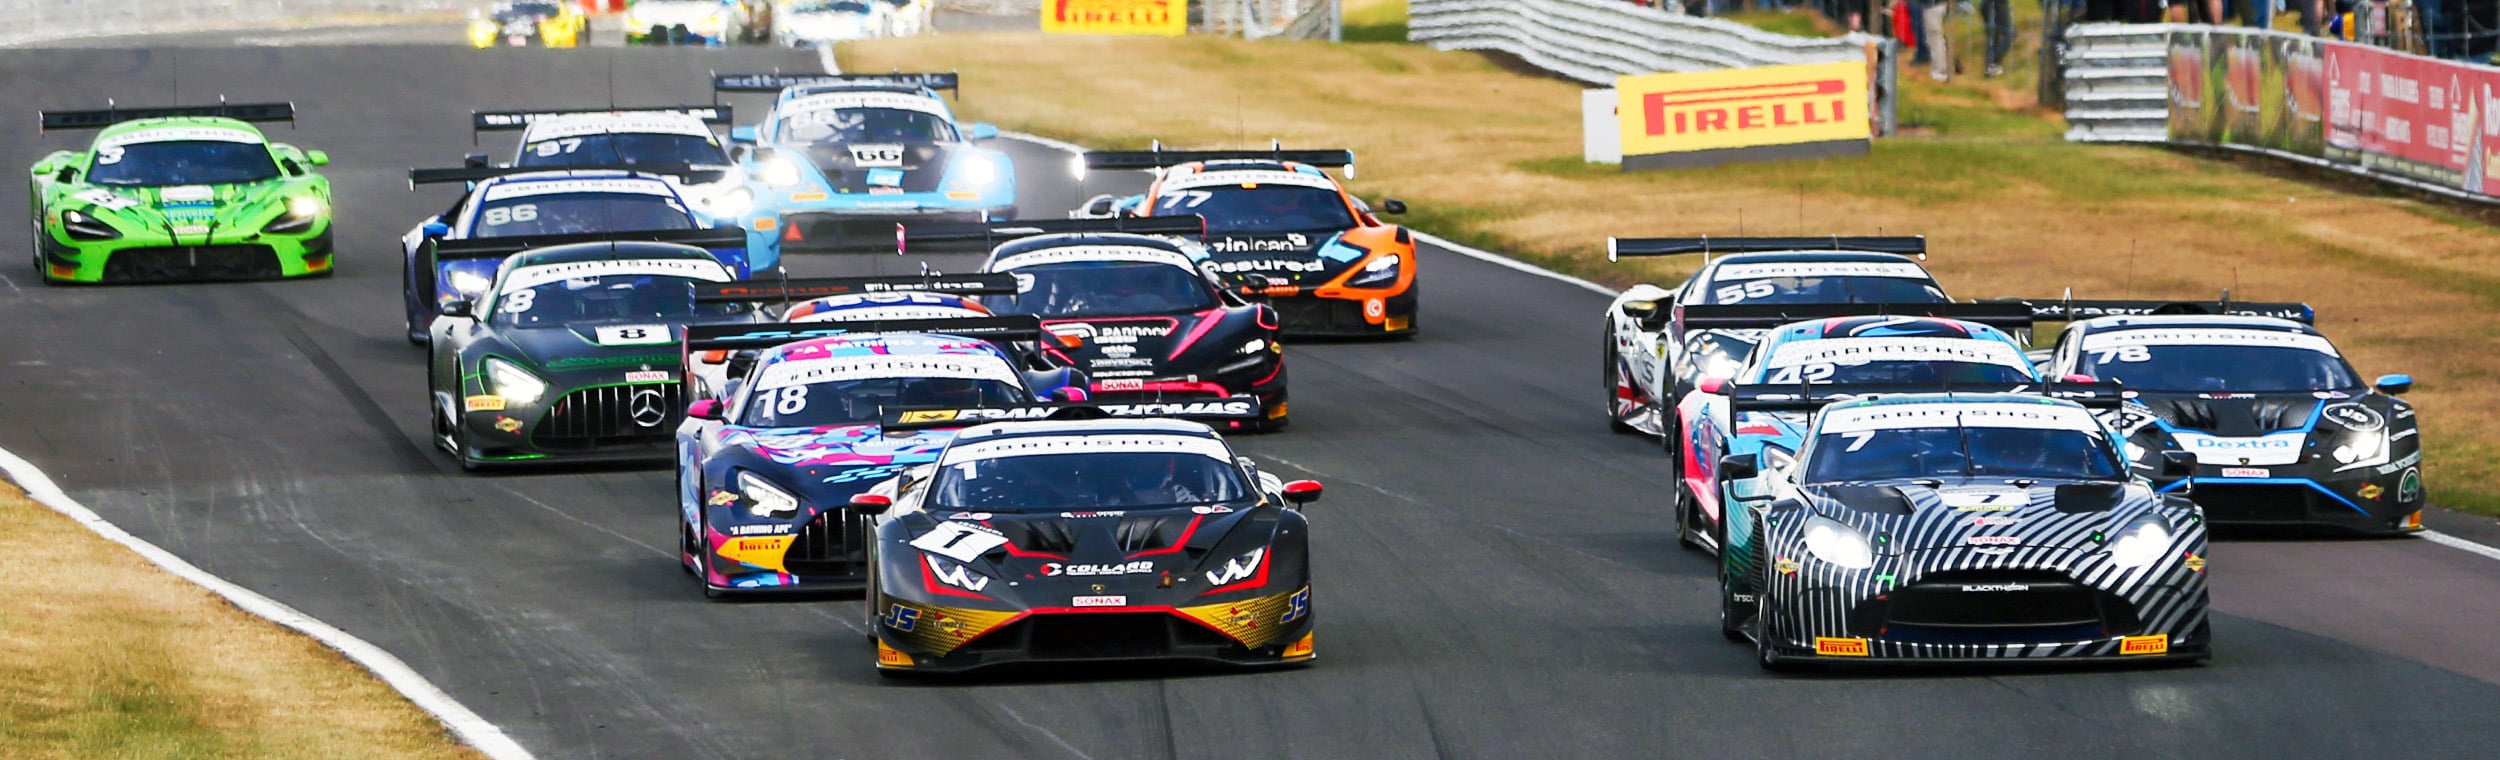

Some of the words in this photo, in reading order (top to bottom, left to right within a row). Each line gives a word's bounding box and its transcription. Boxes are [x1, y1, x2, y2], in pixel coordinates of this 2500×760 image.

[1643, 79, 1846, 136] PIRELLI
[536, 137, 584, 157] 97
[857, 150, 899, 160] 66
[1163, 191, 1213, 209] 77
[485, 204, 538, 226] 86
[504, 289, 536, 313] 8
[1717, 280, 1775, 305] 55
[619, 329, 647, 340] 8
[1805, 345, 1992, 361] #BRITISHGT
[2088, 346, 2151, 364] 78
[790, 362, 983, 381] #BRITISHGT
[1769, 363, 1836, 385] 42
[1103, 381, 1141, 390] SONAX
[755, 385, 809, 419] 18
[956, 406, 1050, 420] FRAN
[1099, 402, 1252, 417] THOMAS
[1852, 409, 2061, 423] #BRITISHGT
[977, 439, 1186, 453] #BRITISHGT
[1842, 429, 1878, 453] 7
[2197, 438, 2289, 449] Dextra
[955, 461, 978, 480] 1
[739, 539, 781, 550] PIRELLI
[943, 530, 974, 549] 1
[1066, 561, 1154, 573] COLLARD
[1074, 597, 1122, 605] SONAX
[885, 604, 921, 632] JS
[1820, 640, 1863, 653] PIRELLI
[2126, 637, 2164, 651] PIRELLI
